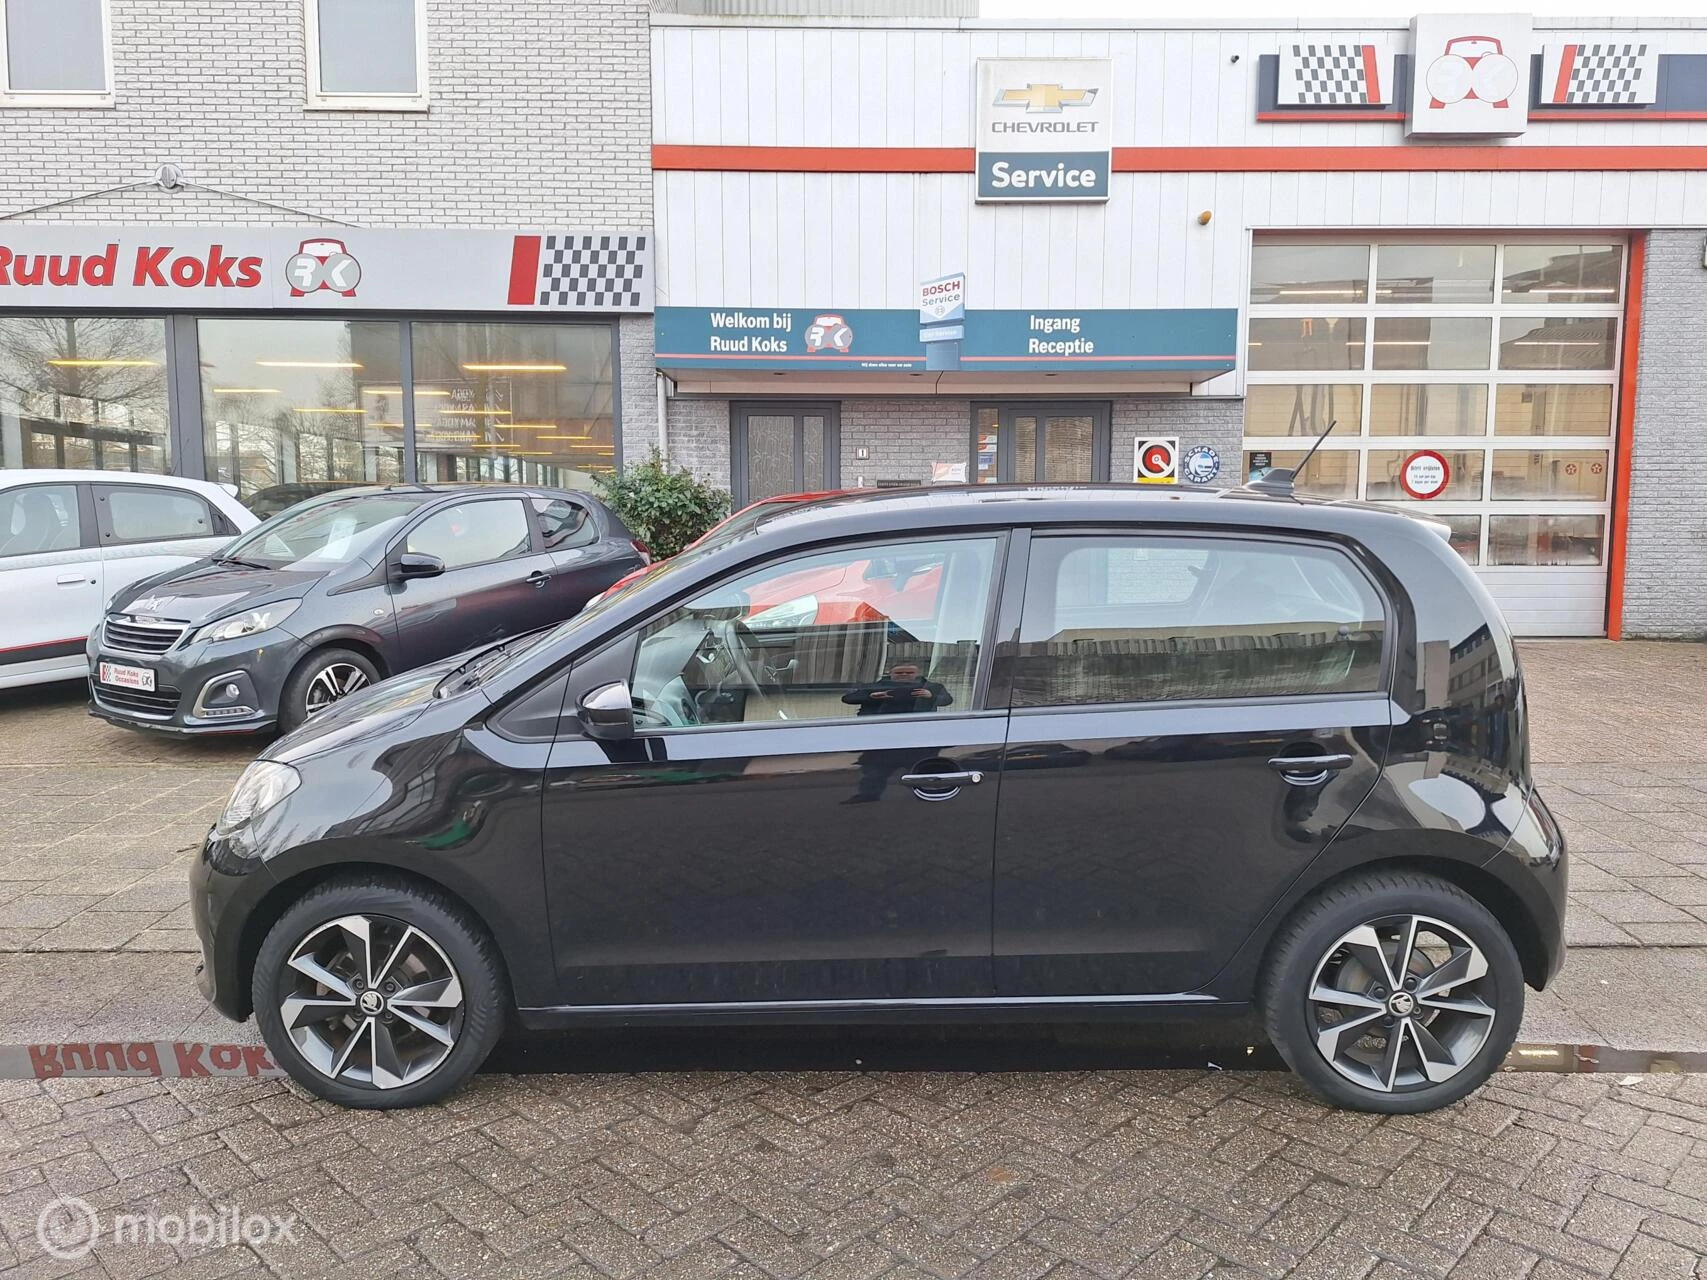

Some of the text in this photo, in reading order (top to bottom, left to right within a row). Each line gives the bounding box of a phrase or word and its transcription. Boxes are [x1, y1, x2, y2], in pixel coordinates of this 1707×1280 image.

[991, 121, 1099, 133] CHEVROLET
[991, 161, 1096, 188] Service
[132, 245, 263, 288] Koks
[922, 280, 961, 297] BOSCH
[922, 293, 961, 307] Service
[710, 312, 791, 333] Welkom bij
[1029, 315, 1080, 333] Ingang
[710, 335, 787, 352] Ruud Koks
[1028, 338, 1094, 356] Receptie
[1184, 446, 1220, 464] SCHADE
[115, 675, 139, 685] Occasions
